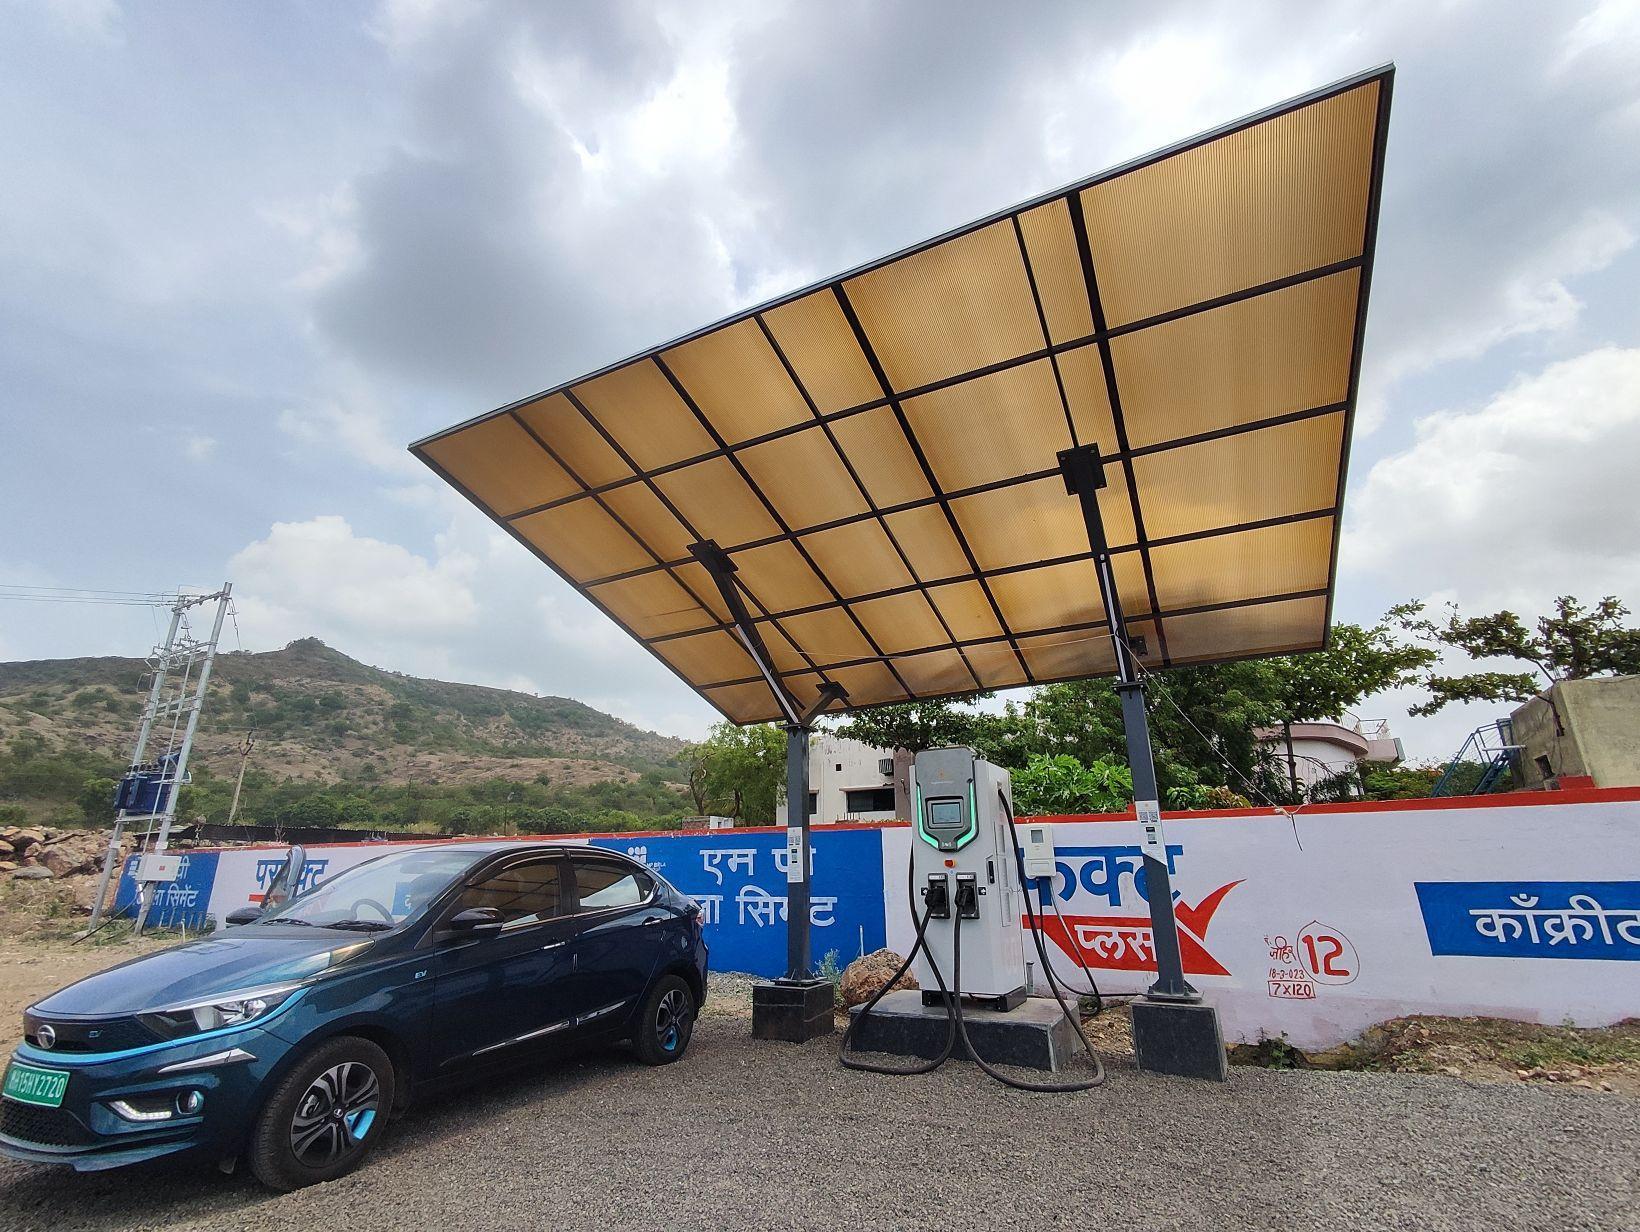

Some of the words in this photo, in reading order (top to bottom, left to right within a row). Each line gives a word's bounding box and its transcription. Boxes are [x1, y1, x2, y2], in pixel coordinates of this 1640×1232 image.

[700, 848, 757, 886] एम
[415, 969, 427, 979] EV
[1302, 934, 1350, 977] 12
